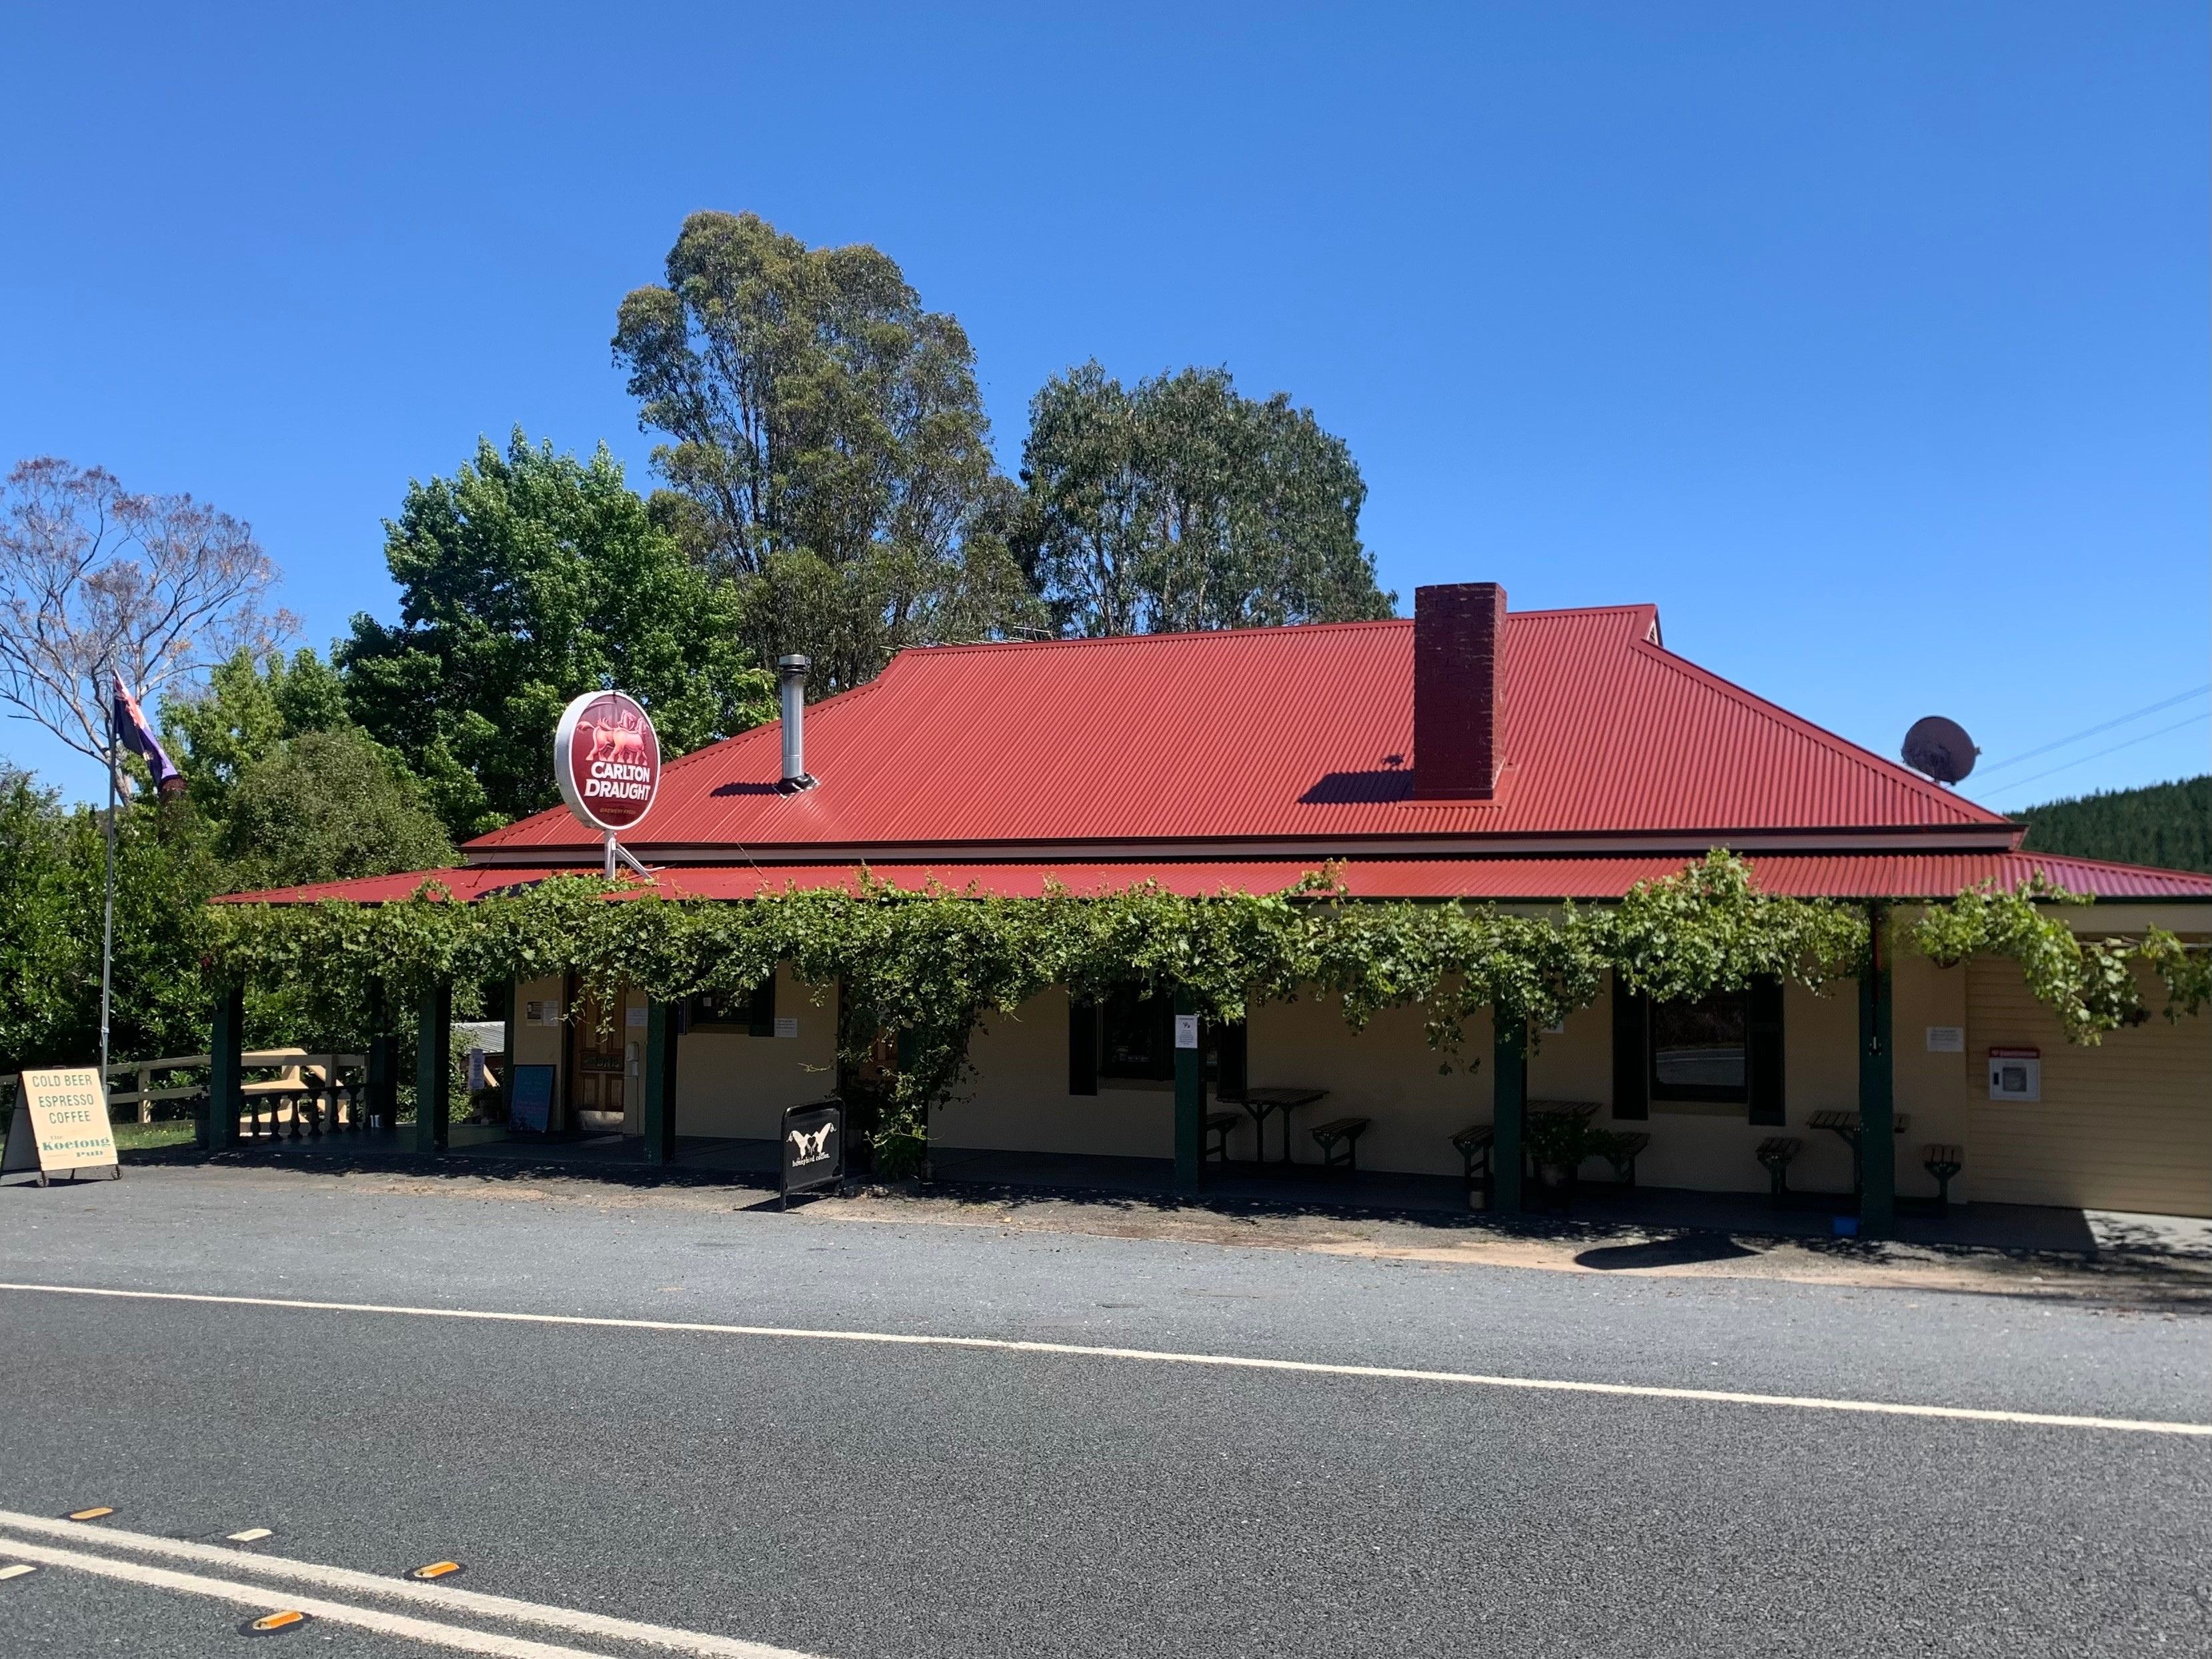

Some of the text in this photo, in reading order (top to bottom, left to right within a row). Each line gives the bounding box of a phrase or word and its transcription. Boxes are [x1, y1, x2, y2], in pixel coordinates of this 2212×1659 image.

[591, 761, 650, 783] CARLTON
[584, 778, 651, 801] DRAUGHT
[32, 1074, 92, 1088] COLD BEER
[38, 1094, 94, 1108] ESPRESSO
[49, 1110, 91, 1124] COFFEE
[42, 1136, 111, 1152] Koetong
